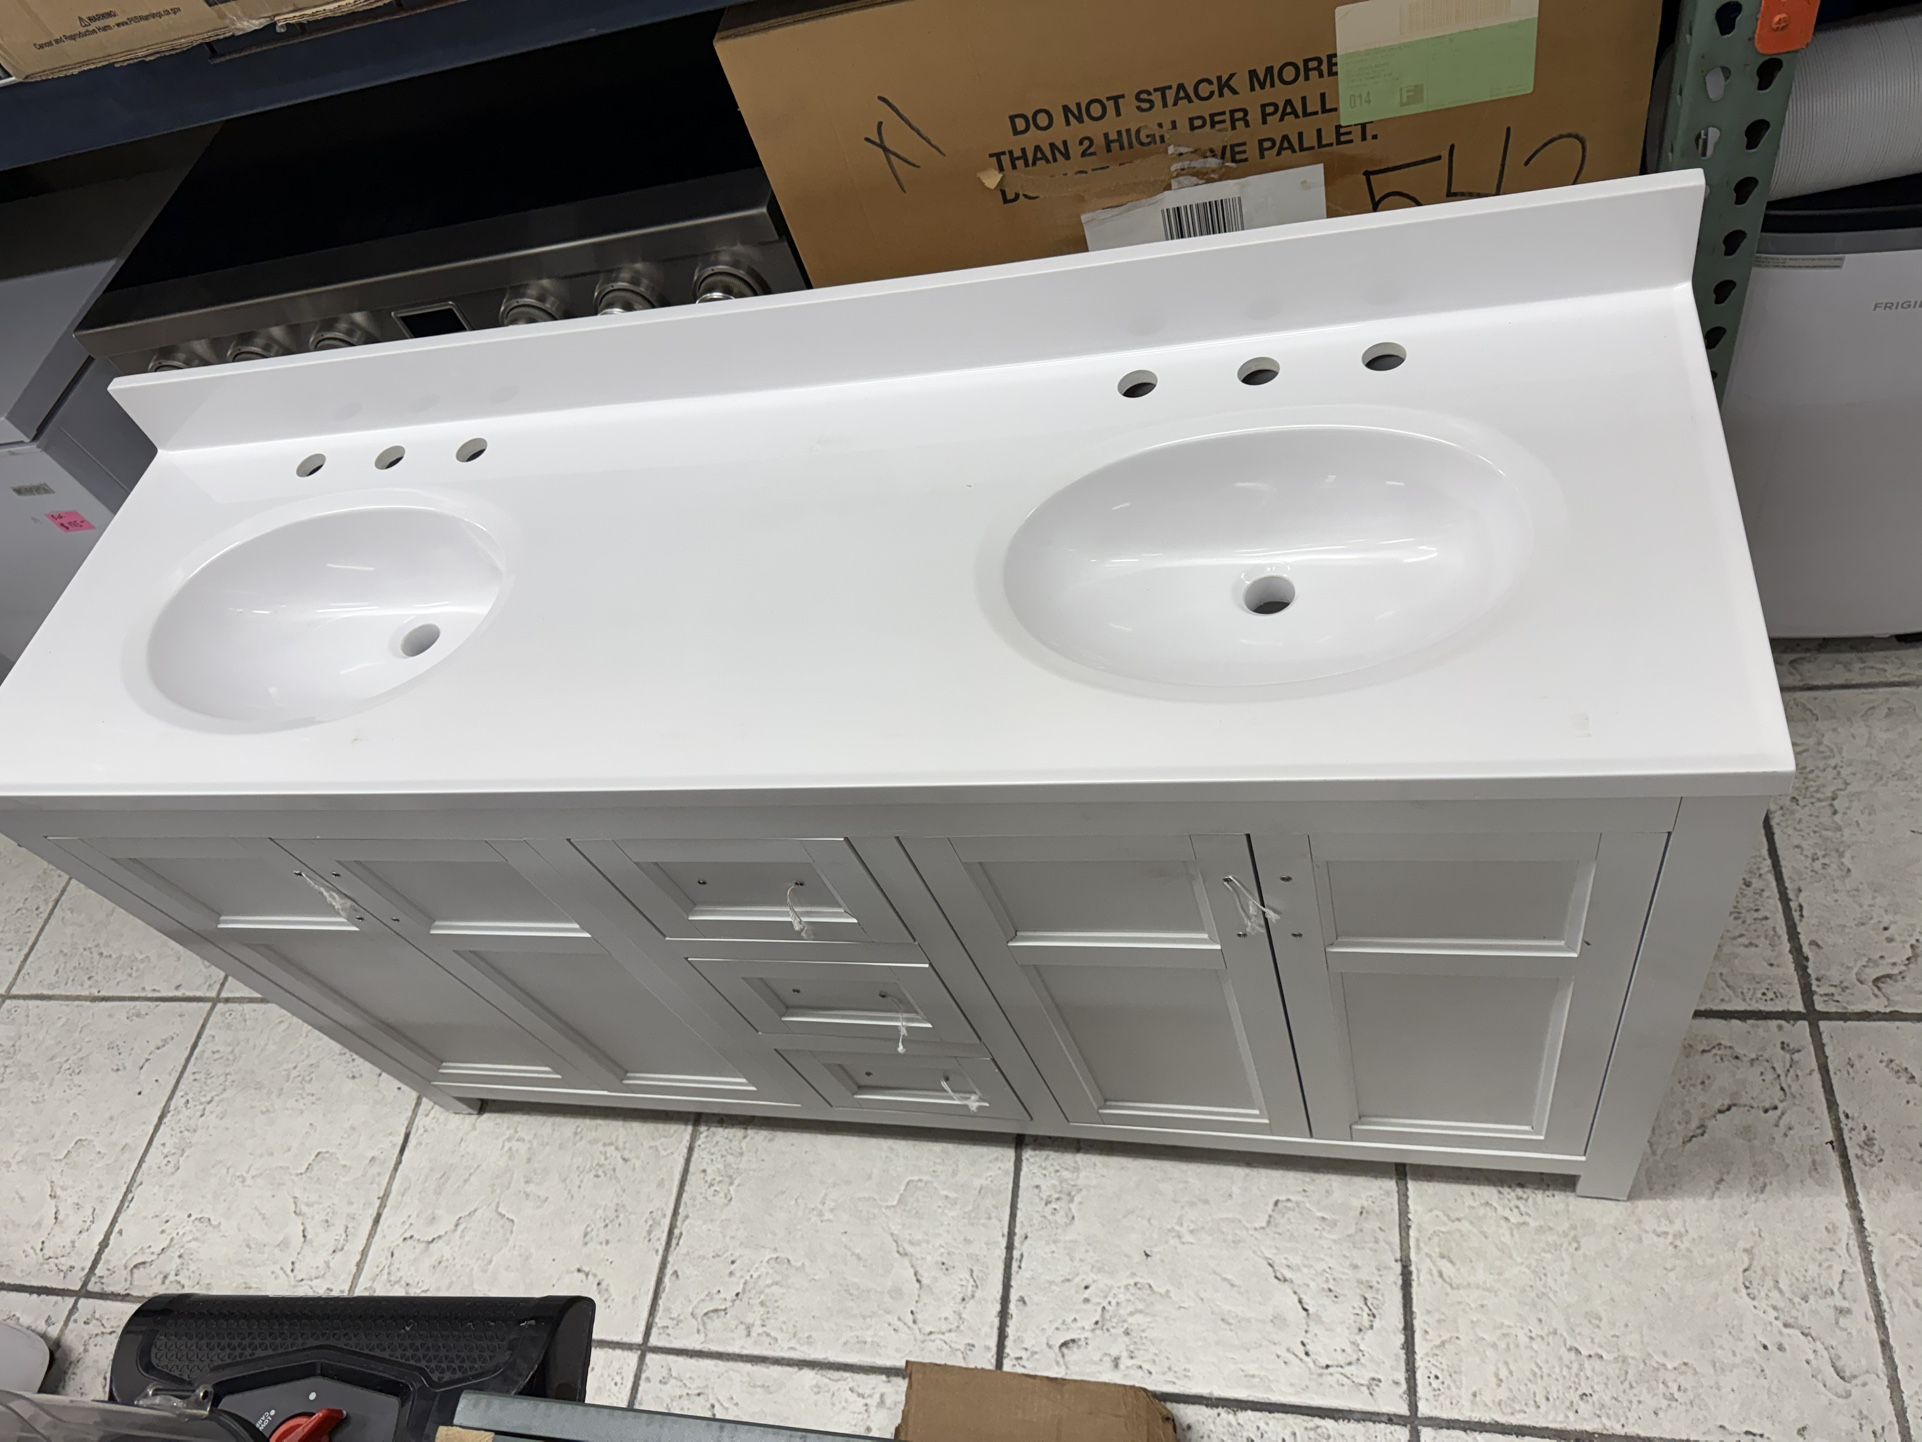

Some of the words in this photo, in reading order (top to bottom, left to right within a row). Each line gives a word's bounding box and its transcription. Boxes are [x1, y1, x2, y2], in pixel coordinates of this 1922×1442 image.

[1008, 107, 1054, 137] DO
[1061, 93, 1126, 127] NOT
[1134, 72, 1240, 113] STACK
[1247, 53, 1338, 93] MORE
[988, 139, 1072, 173] THAN
[1078, 135, 1097, 158] 2
[1259, 92, 1338, 126] PALL
[1257, 120, 1379, 160] PALLET.
[259, 1416, 272, 1431] LOW
